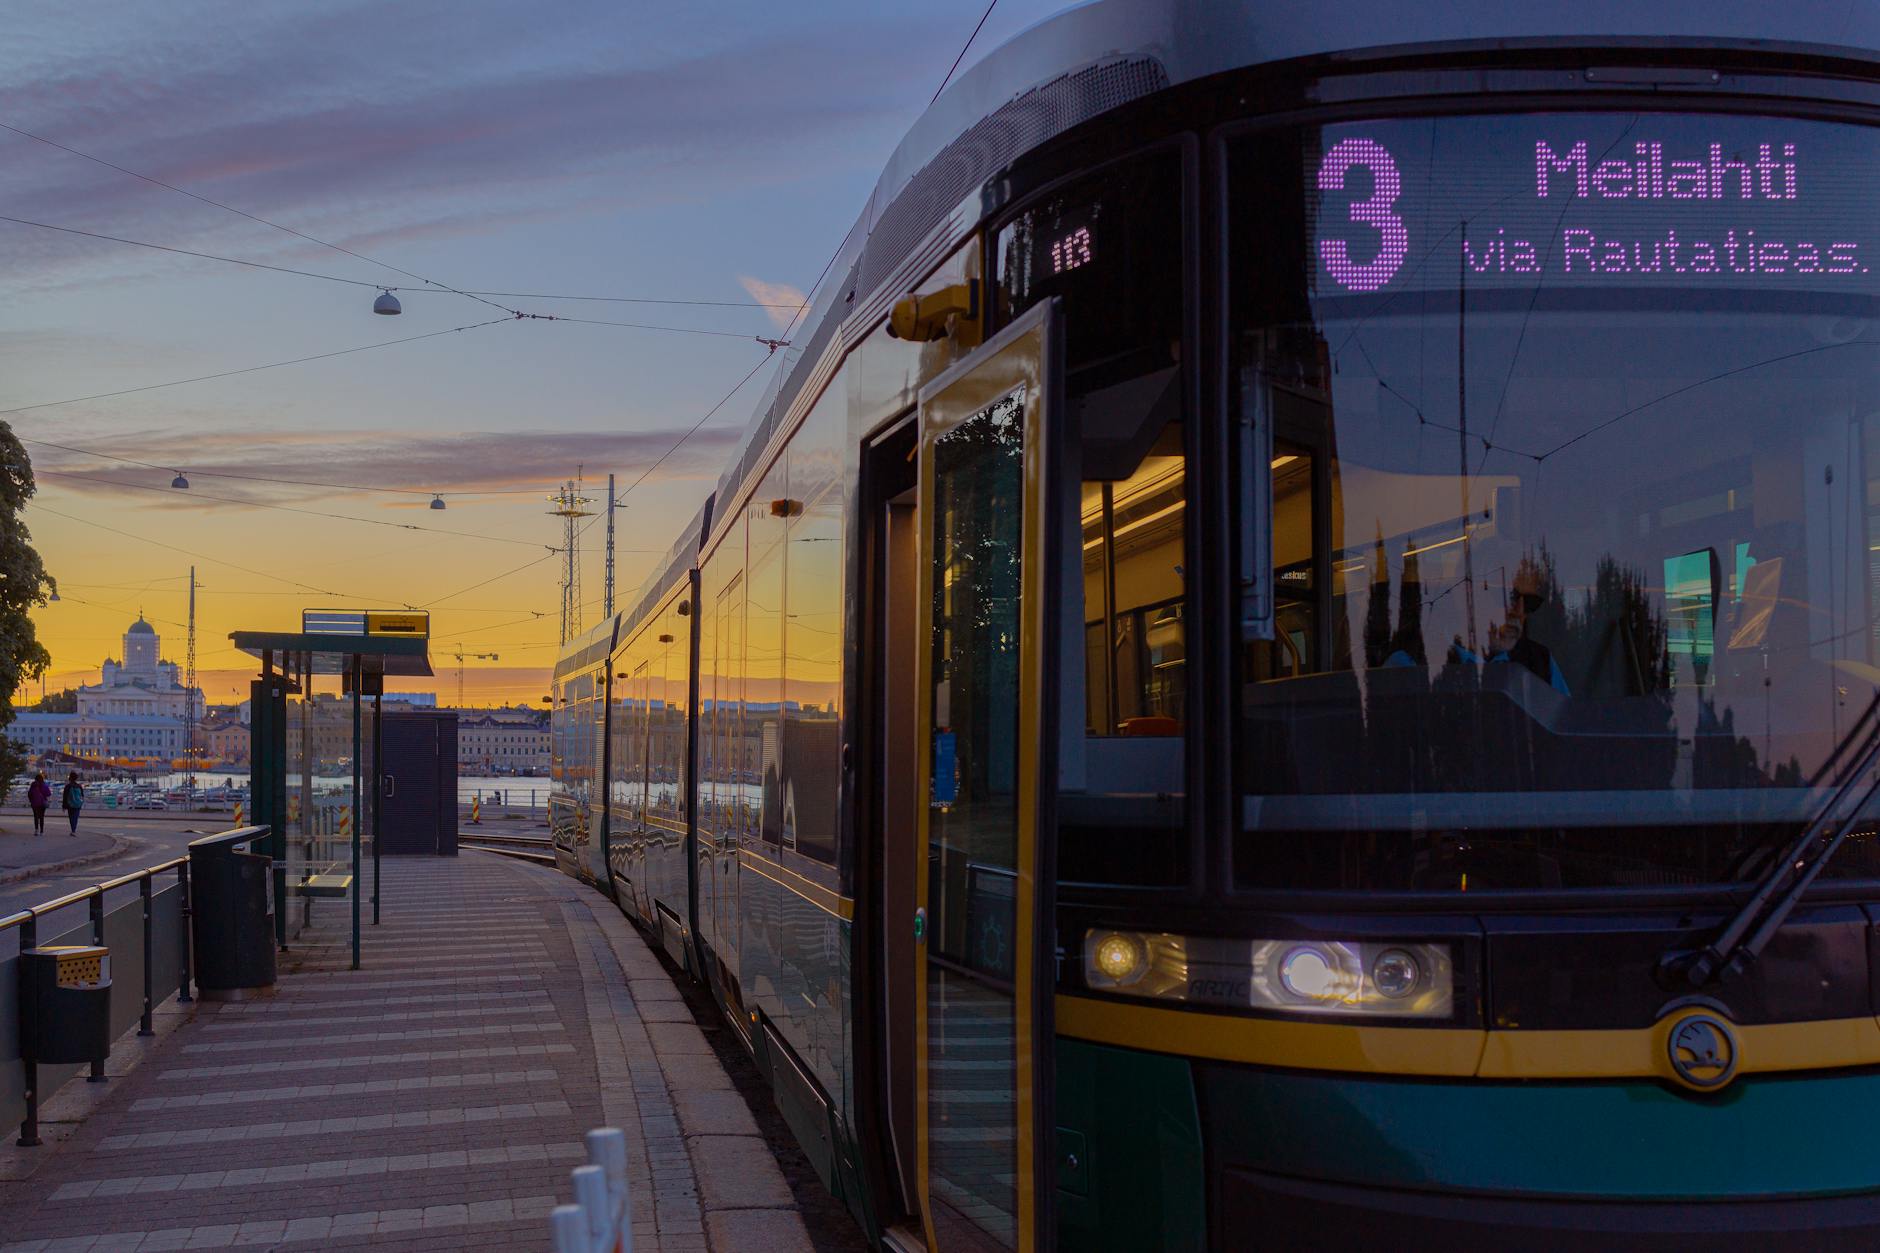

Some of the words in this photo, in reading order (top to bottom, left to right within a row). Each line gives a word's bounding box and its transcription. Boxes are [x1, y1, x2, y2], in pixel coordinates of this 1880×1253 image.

[1535, 140, 1797, 200] Meilahti
[1318, 137, 1408, 291] 3
[1462, 228, 1541, 273] via
[1564, 228, 1869, 274] Rautatieas.
